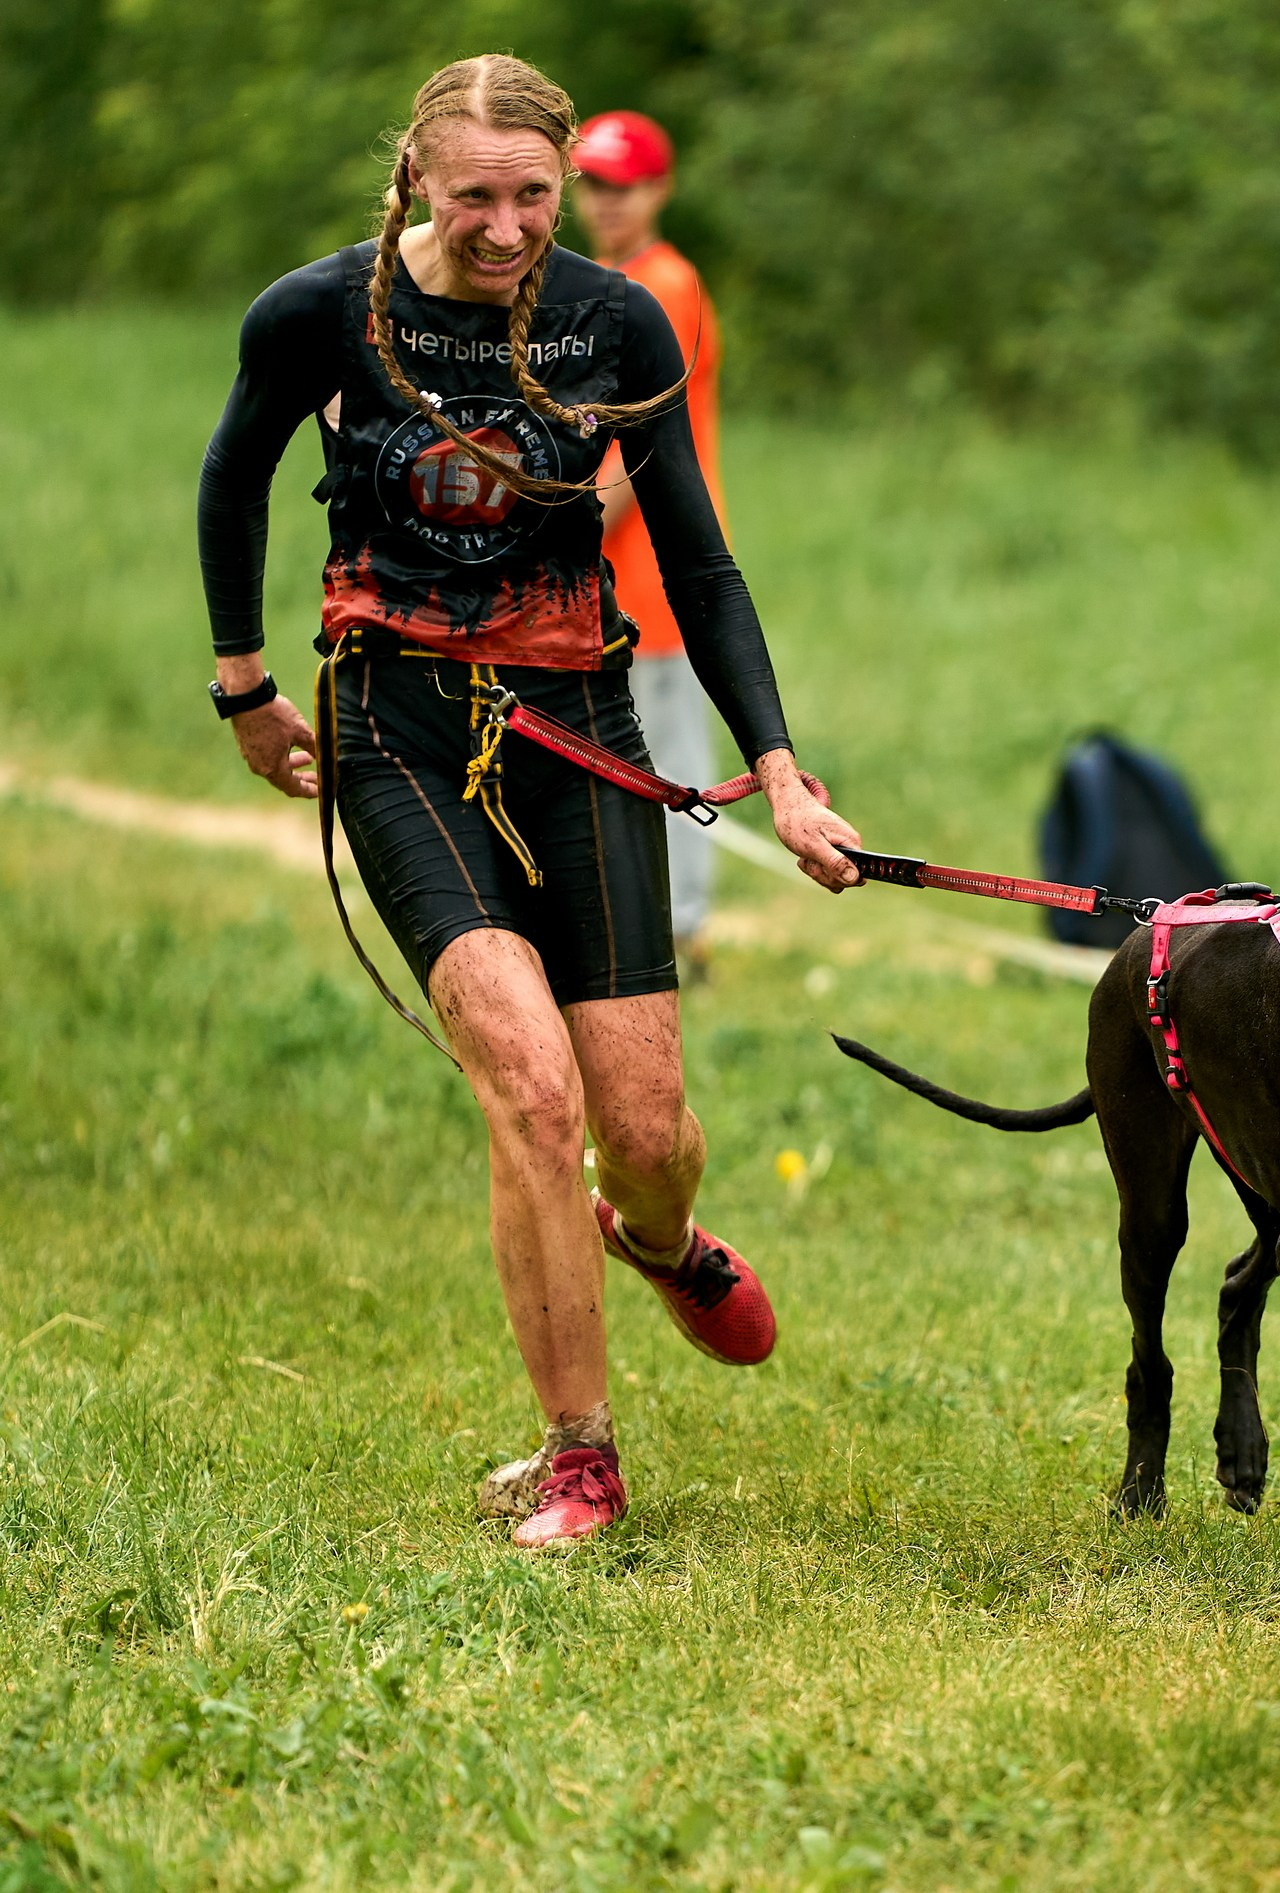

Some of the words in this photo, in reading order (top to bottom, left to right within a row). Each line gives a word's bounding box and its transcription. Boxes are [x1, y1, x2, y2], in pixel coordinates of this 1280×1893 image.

[400, 327, 513, 364] четыре
[484, 408, 550, 482] EXREME
[412, 451, 525, 508] 157
